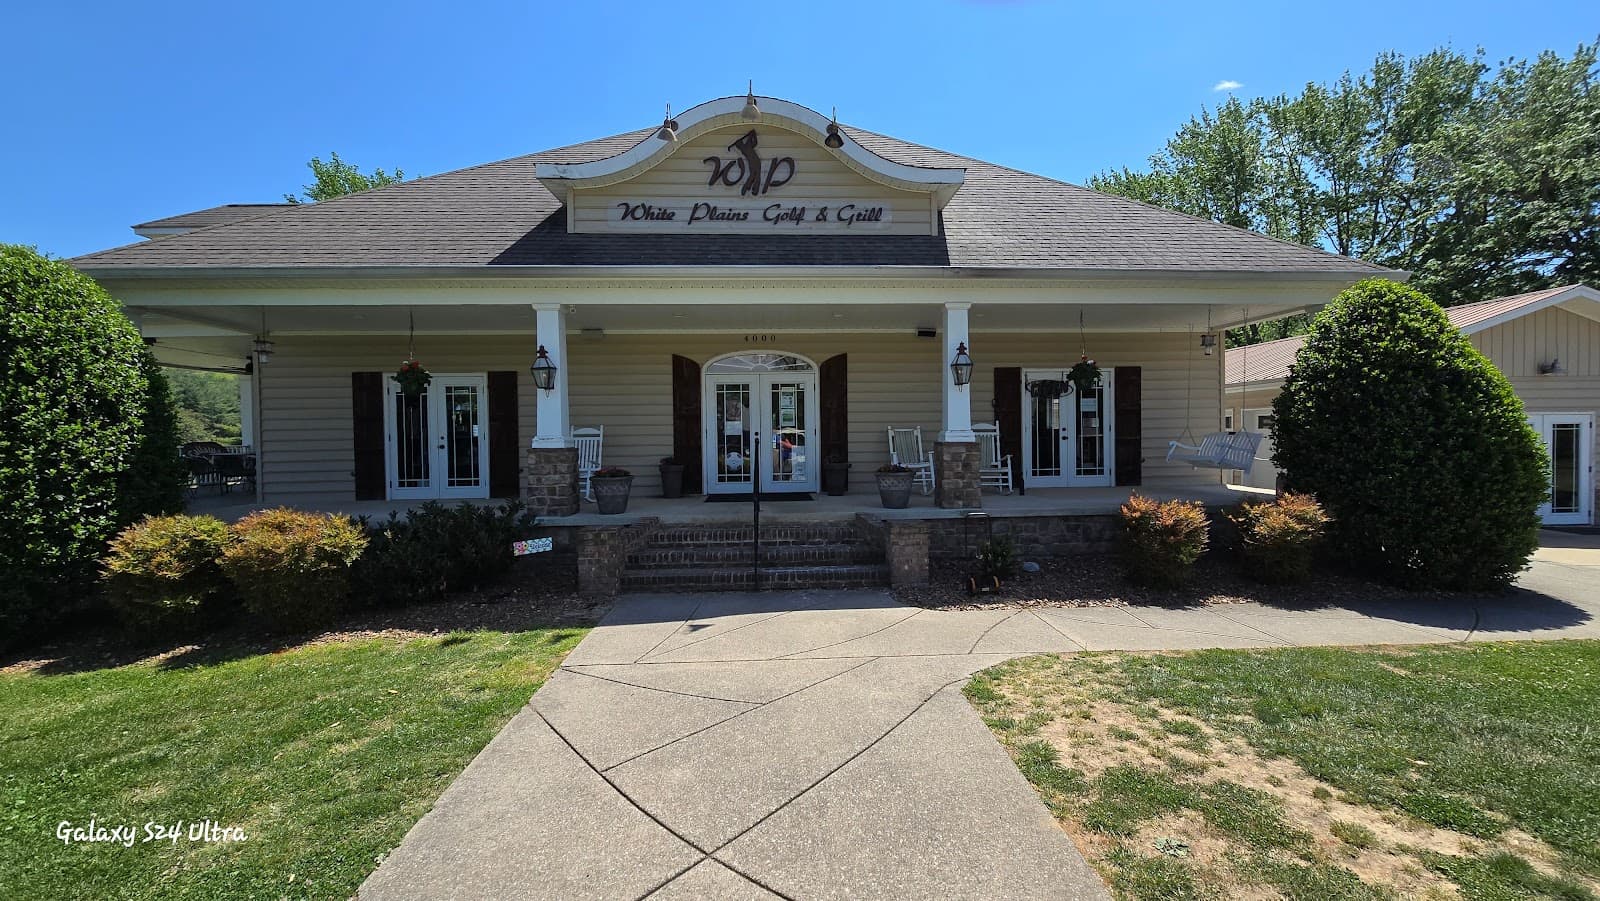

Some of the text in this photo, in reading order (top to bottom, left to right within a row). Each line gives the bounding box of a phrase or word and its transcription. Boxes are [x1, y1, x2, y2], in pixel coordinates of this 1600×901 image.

[617, 202, 882, 225] White Plains Golf & Grill
[744, 334, 776, 342] 4000
